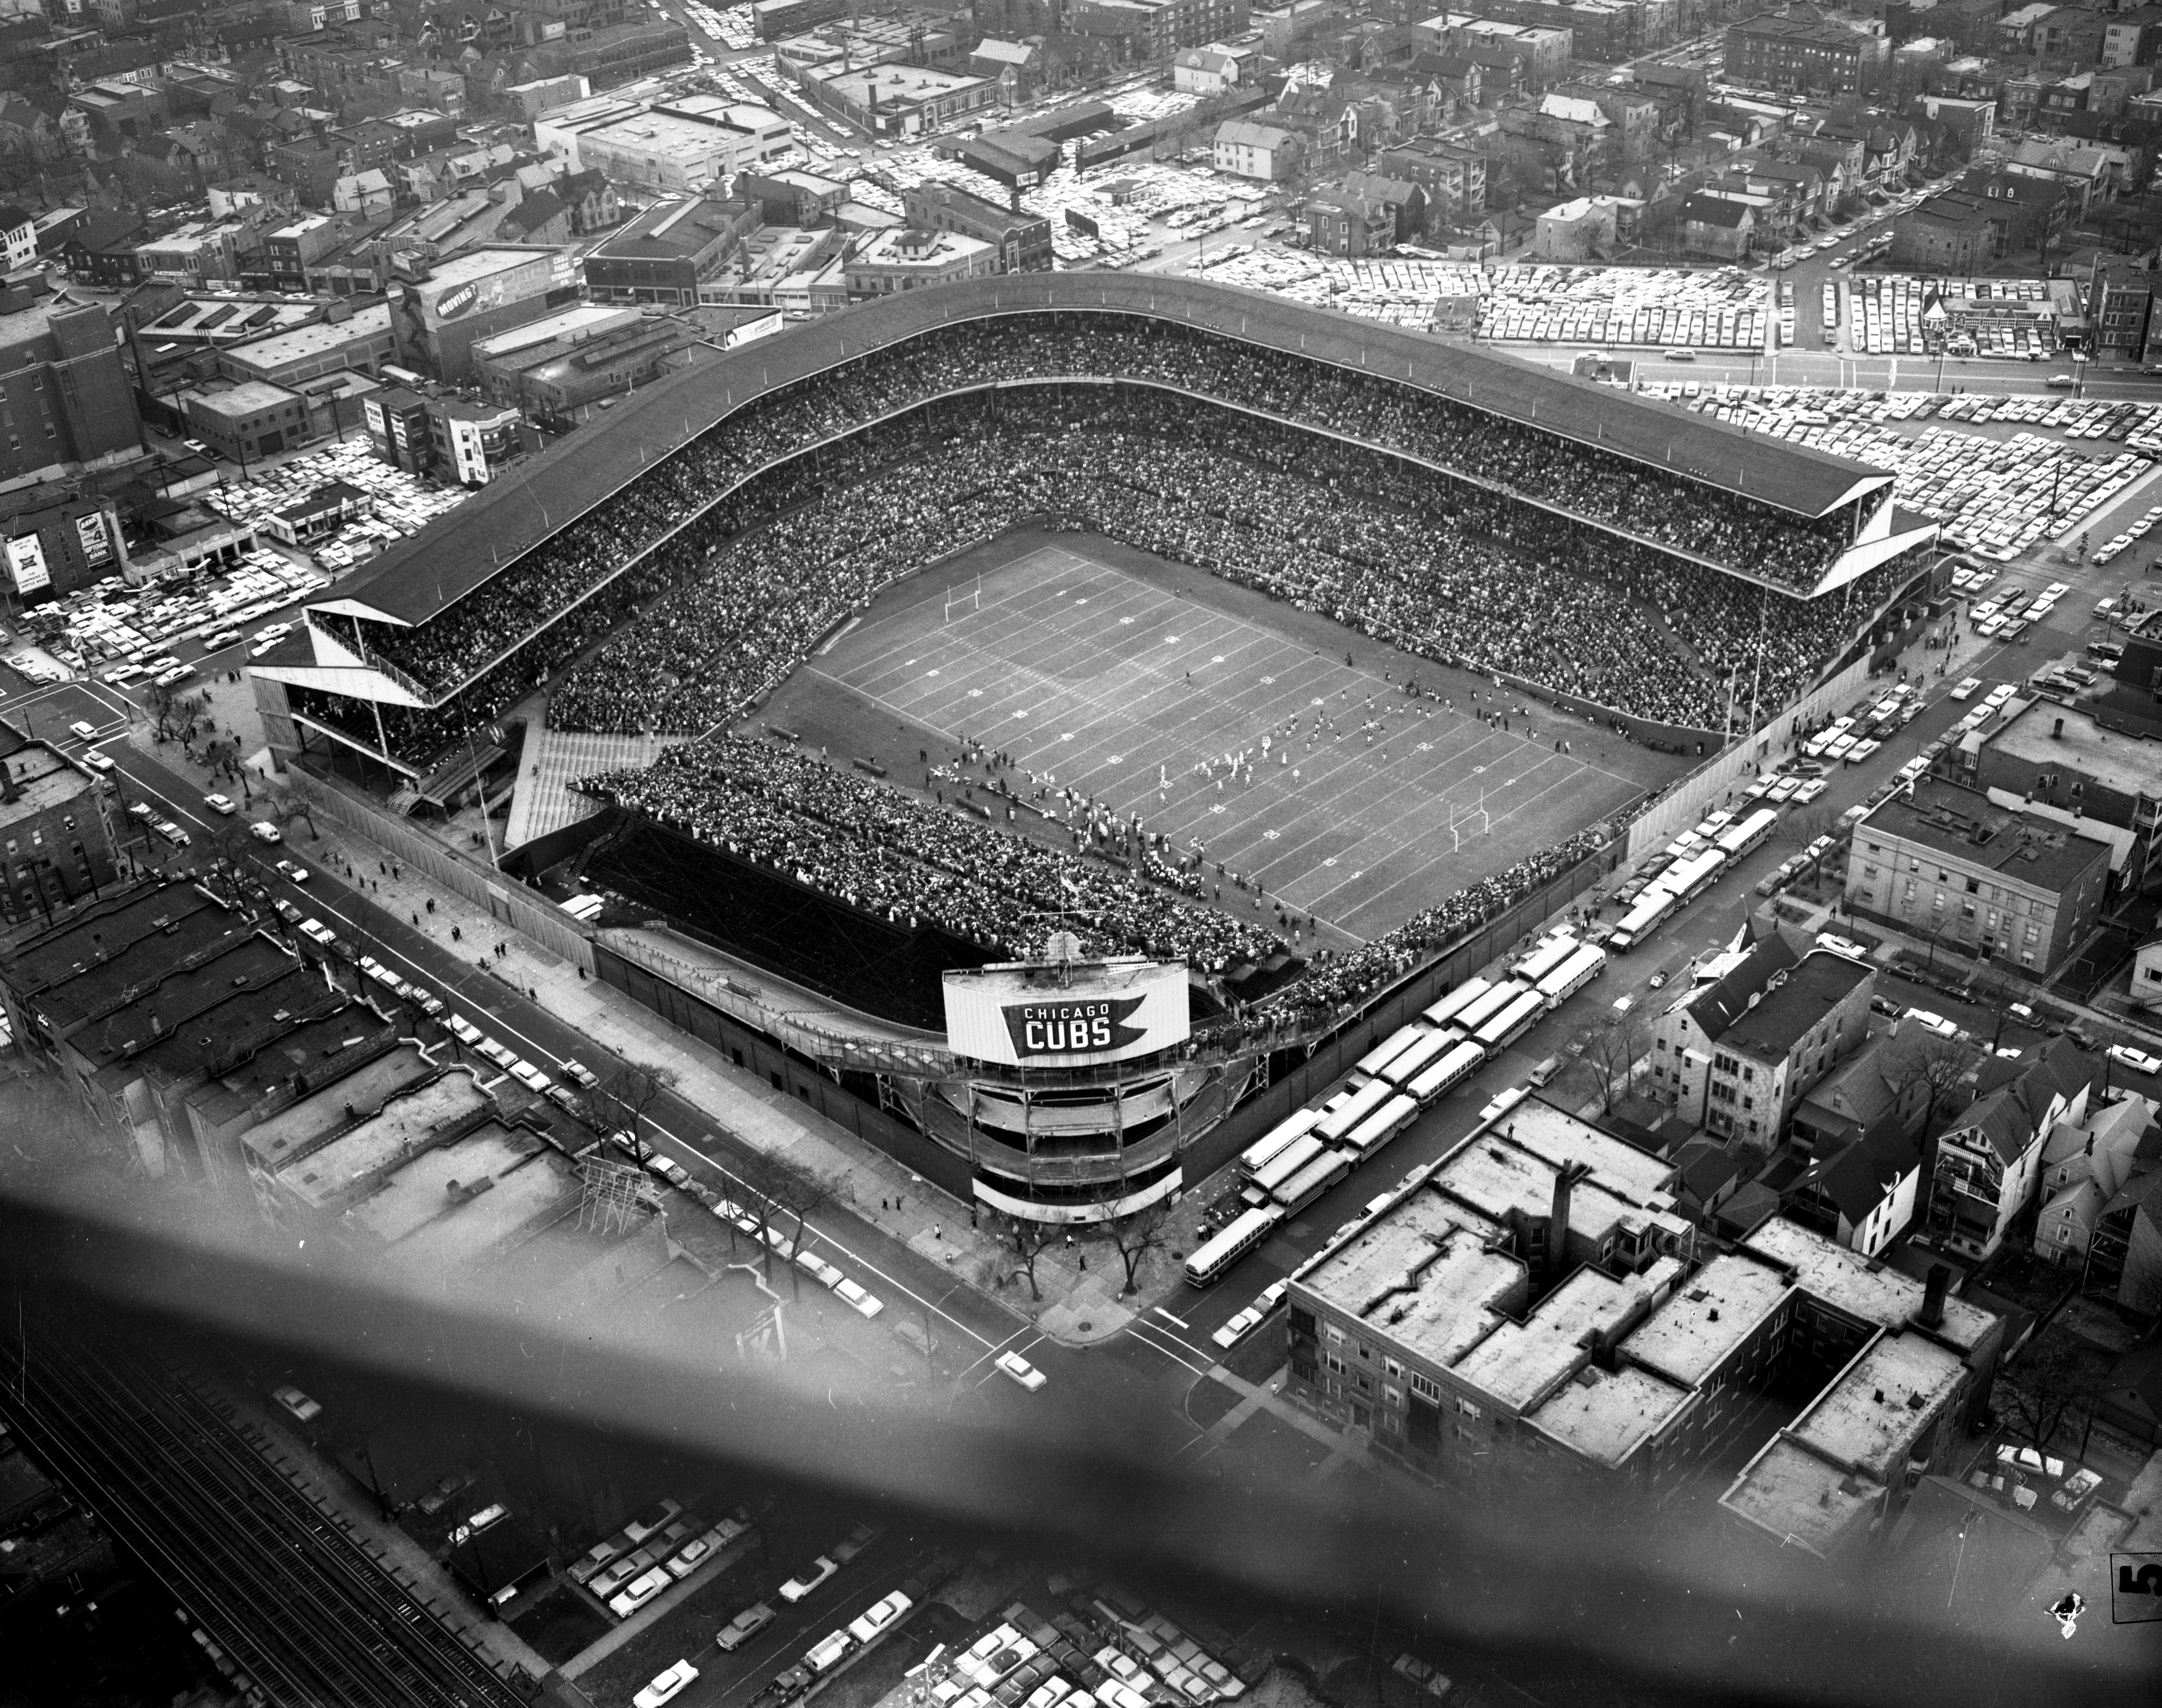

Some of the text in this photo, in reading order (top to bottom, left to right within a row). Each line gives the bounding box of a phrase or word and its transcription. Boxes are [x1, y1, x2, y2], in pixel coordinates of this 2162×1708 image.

[554, 262, 570, 272] PARK
[551, 268, 575, 282] STORAGE
[438, 284, 476, 316] MOVING?
[81, 517, 97, 529] BANK
[85, 540, 108, 553] UPTOWN
[89, 549, 107, 560] BANK
[1209, 804, 1226, 813] 30
[1263, 830, 1280, 839] 20
[1025, 1004, 1109, 1019] CHICAGO
[1026, 1017, 1111, 1050] CUBS
